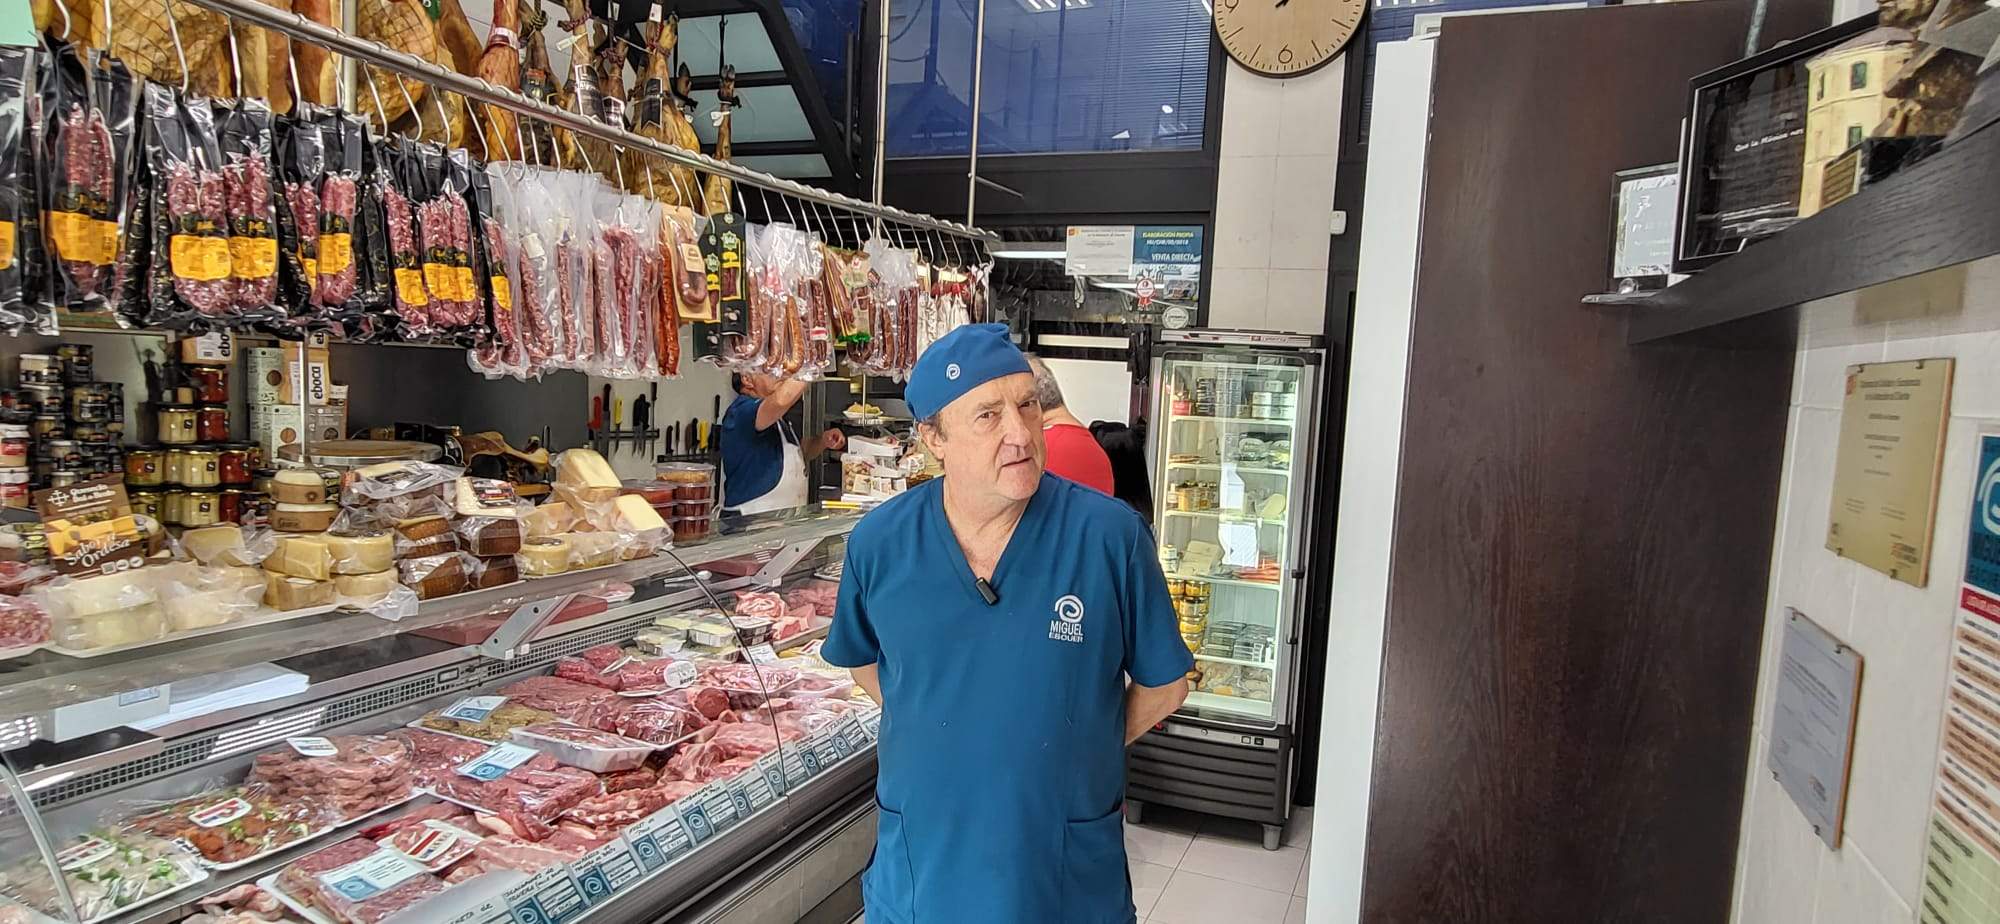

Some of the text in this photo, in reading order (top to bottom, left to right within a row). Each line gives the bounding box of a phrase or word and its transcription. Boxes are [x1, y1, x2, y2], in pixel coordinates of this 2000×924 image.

[1278, 43, 1293, 64] 6
[1151, 253, 1195, 263] VENTA DIRECTA
[218, 333, 231, 357] ebo
[310, 366, 323, 400] eboca
[81, 539, 130, 568] Ordesa
[1050, 620, 1083, 636] MIGUEL
